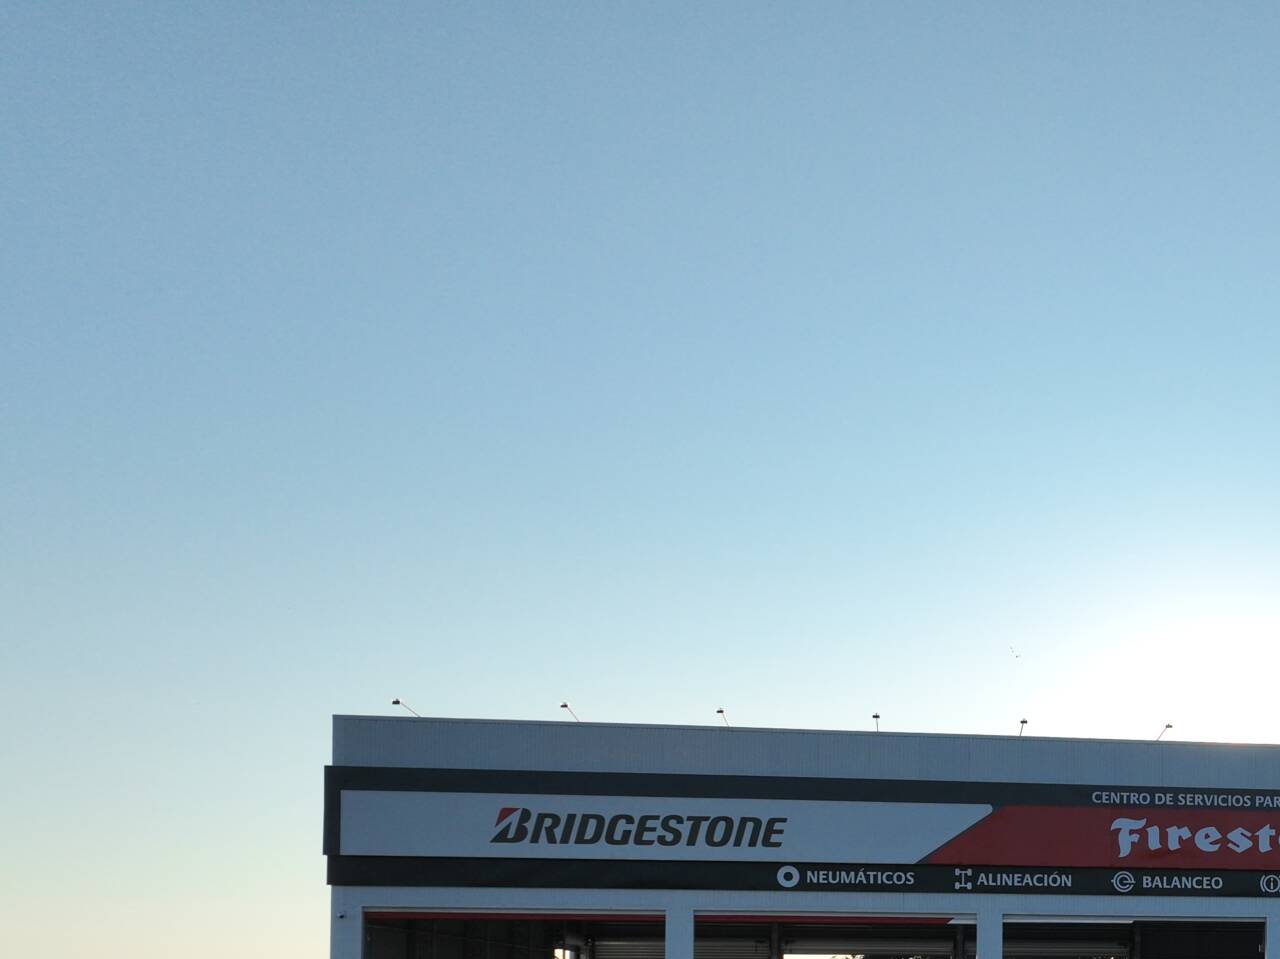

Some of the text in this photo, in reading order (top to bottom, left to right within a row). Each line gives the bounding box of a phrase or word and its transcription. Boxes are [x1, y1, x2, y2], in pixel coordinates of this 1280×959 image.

[1092, 791, 1150, 805] CENTRO
[1155, 793, 1175, 806] DE
[1178, 793, 1252, 808] SERVICIOS
[489, 807, 787, 848] BRIDGESTONE
[806, 868, 915, 886] NEUMÁTICOS
[976, 869, 1073, 889] ALINEACIÓN
[1142, 875, 1224, 890] BALANCEO
